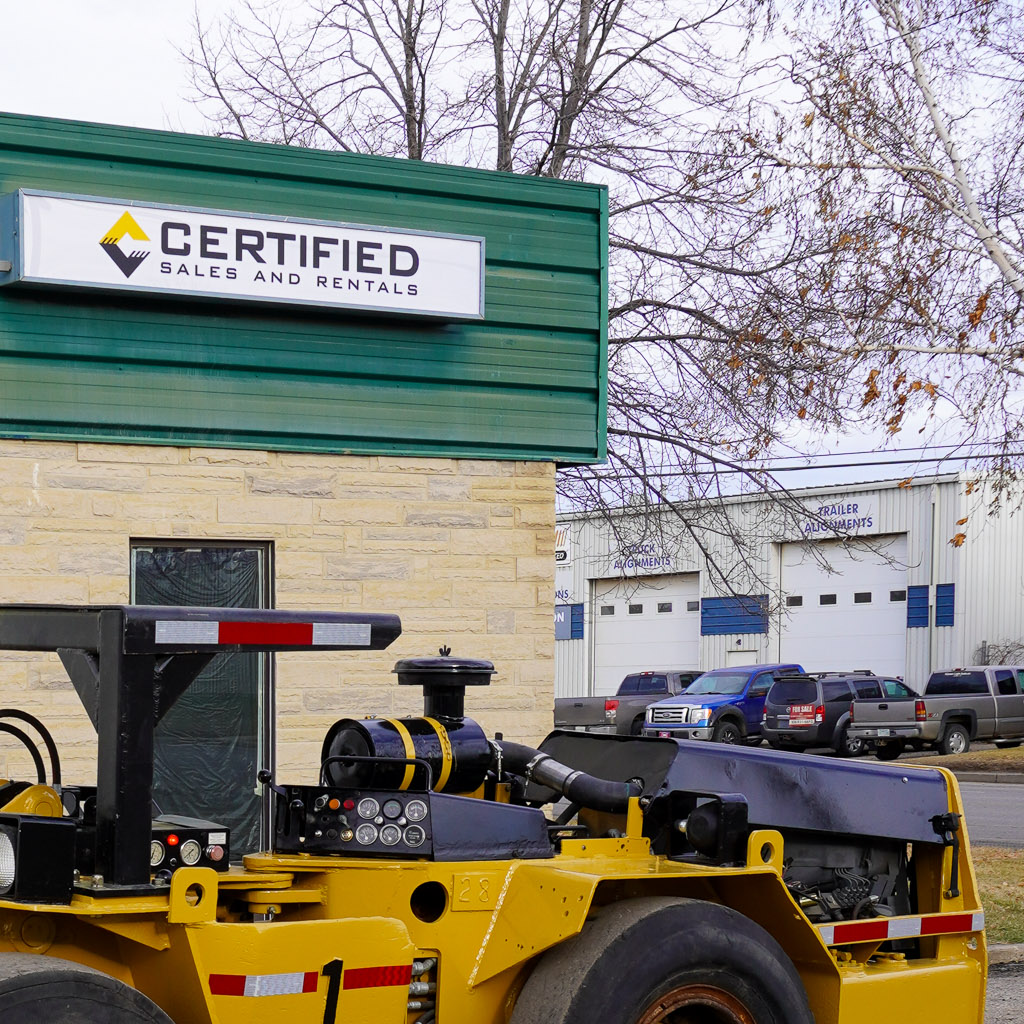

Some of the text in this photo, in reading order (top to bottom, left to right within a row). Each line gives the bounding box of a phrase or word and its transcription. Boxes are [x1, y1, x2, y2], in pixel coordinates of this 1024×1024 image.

[161, 221, 419, 277] CERTIFIED
[160, 261, 418, 296] SALES AND RENTALS
[818, 503, 859, 517] TRAILER
[804, 517, 873, 533] ALIGNMENTS
[801, 705, 813, 713] SALE
